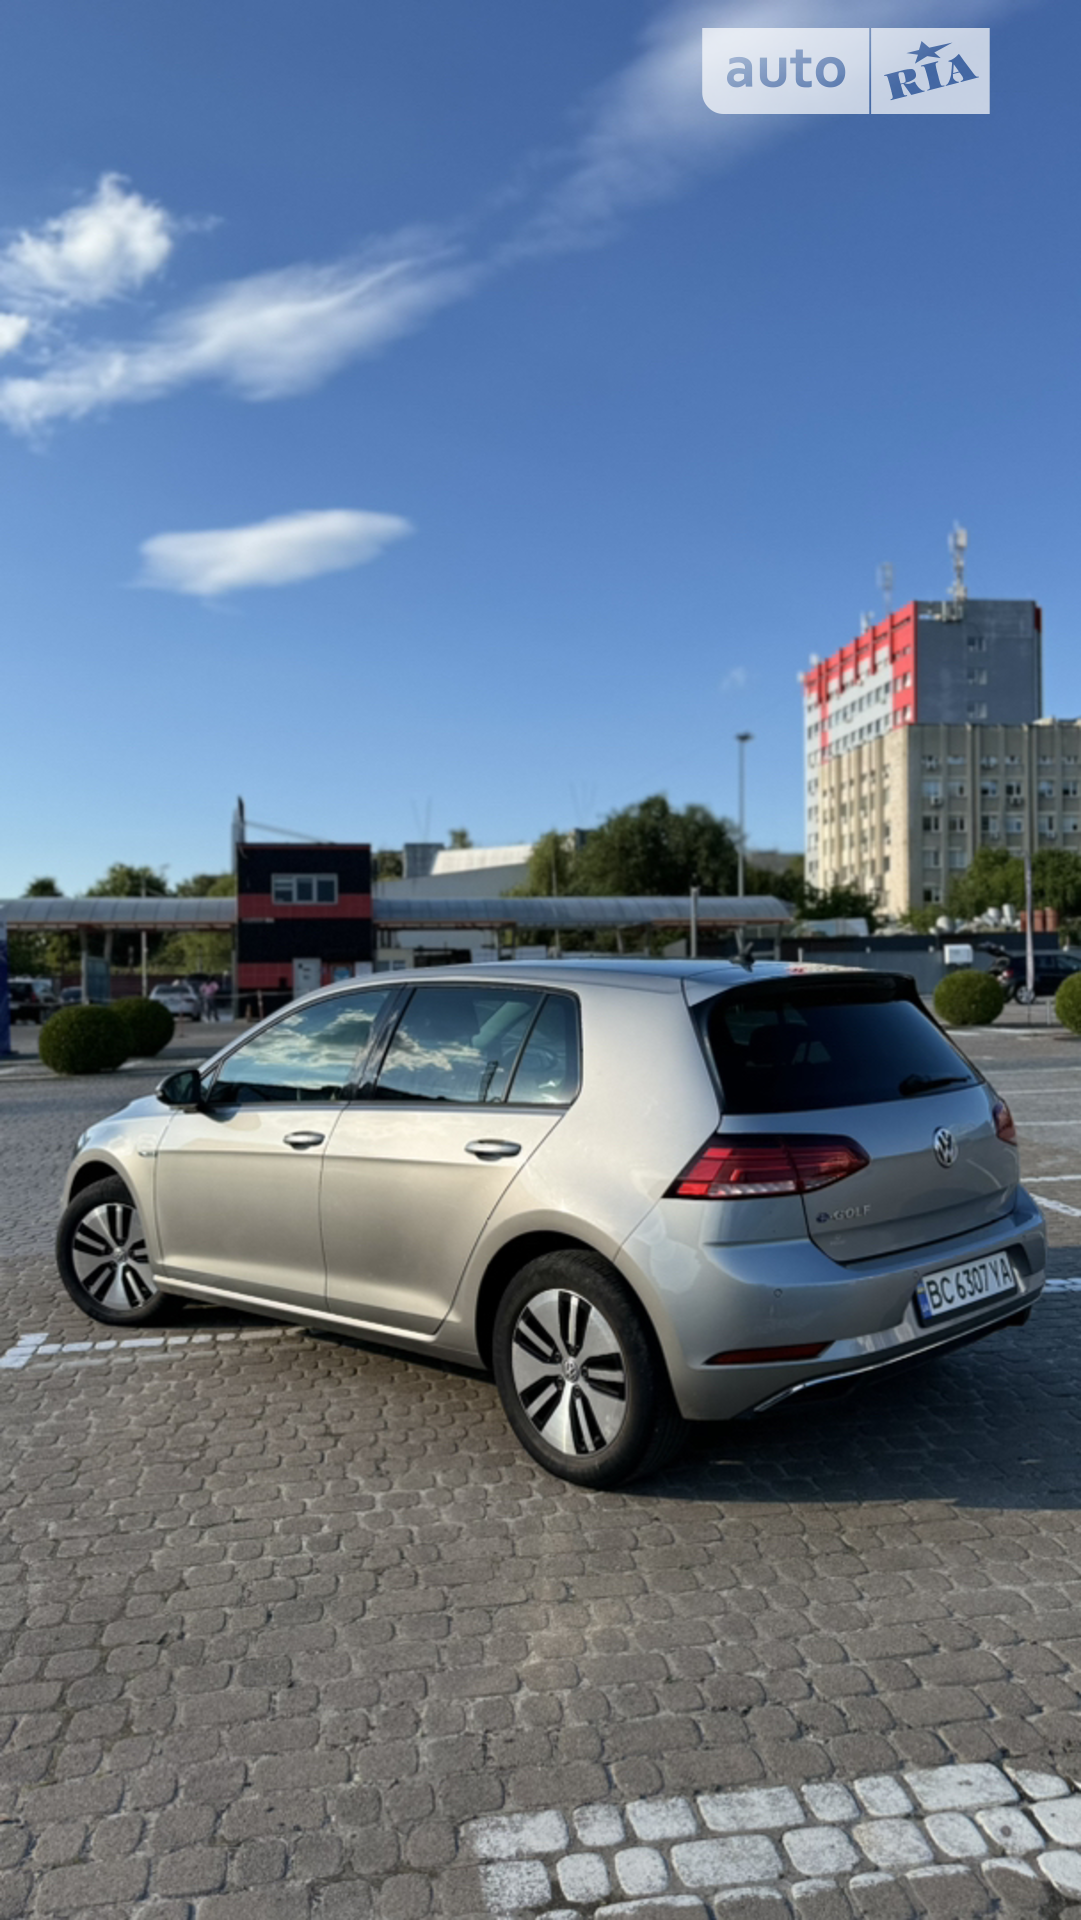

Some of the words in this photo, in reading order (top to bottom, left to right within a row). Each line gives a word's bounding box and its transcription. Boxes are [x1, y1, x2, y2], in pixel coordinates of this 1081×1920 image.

[926, 1276, 955, 1310] BC
[955, 1263, 989, 1300] 6307
[988, 1258, 1012, 1288] YA
